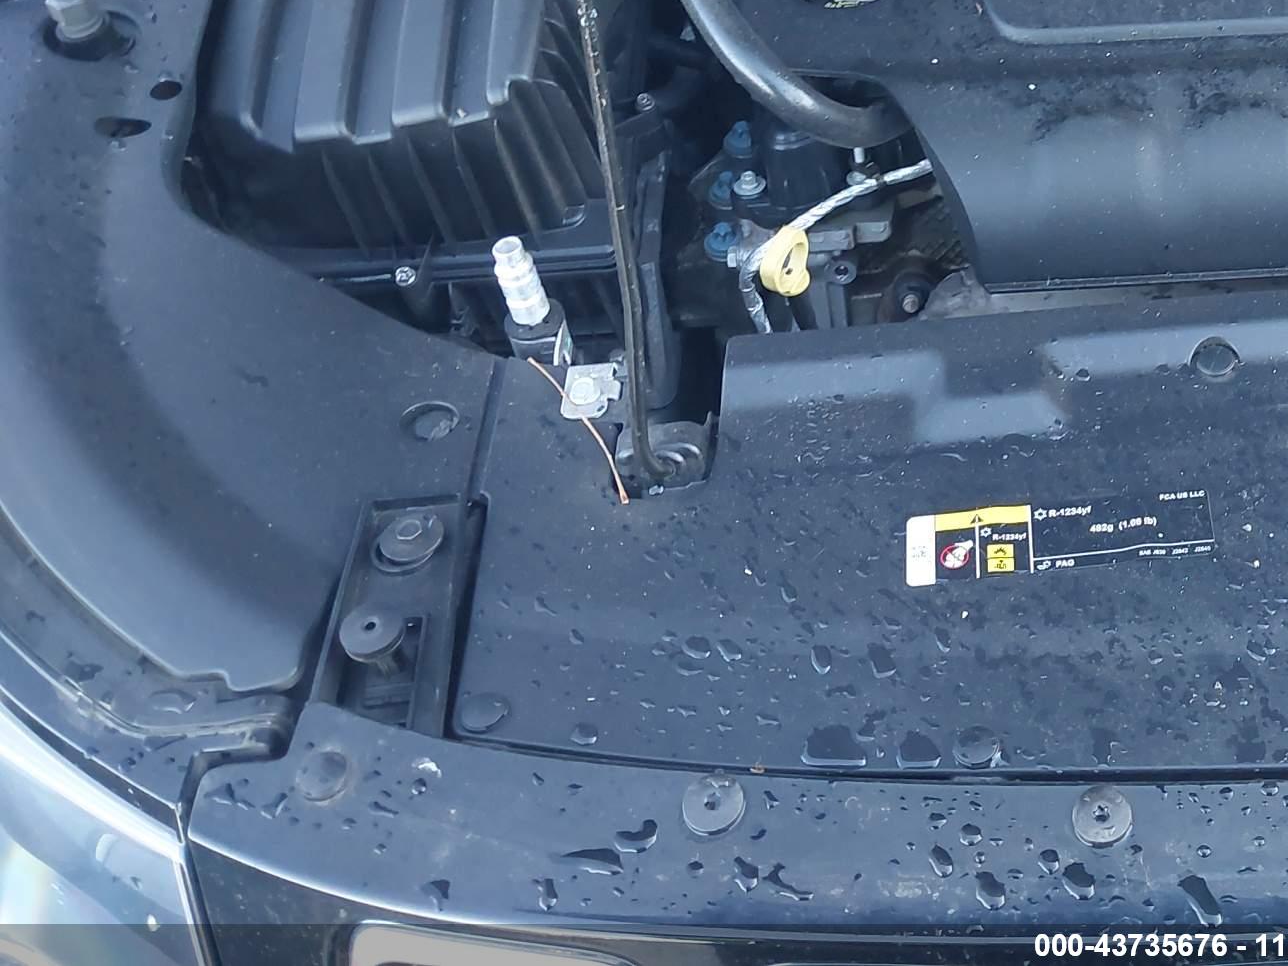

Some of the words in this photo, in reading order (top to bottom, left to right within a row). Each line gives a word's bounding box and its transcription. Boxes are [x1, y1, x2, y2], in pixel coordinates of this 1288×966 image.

[1159, 492, 1176, 501] FCA
[1189, 489, 1205, 498] LLC
[1048, 505, 1092, 518] R-1234yf
[992, 531, 1027, 541] R-1234yf
